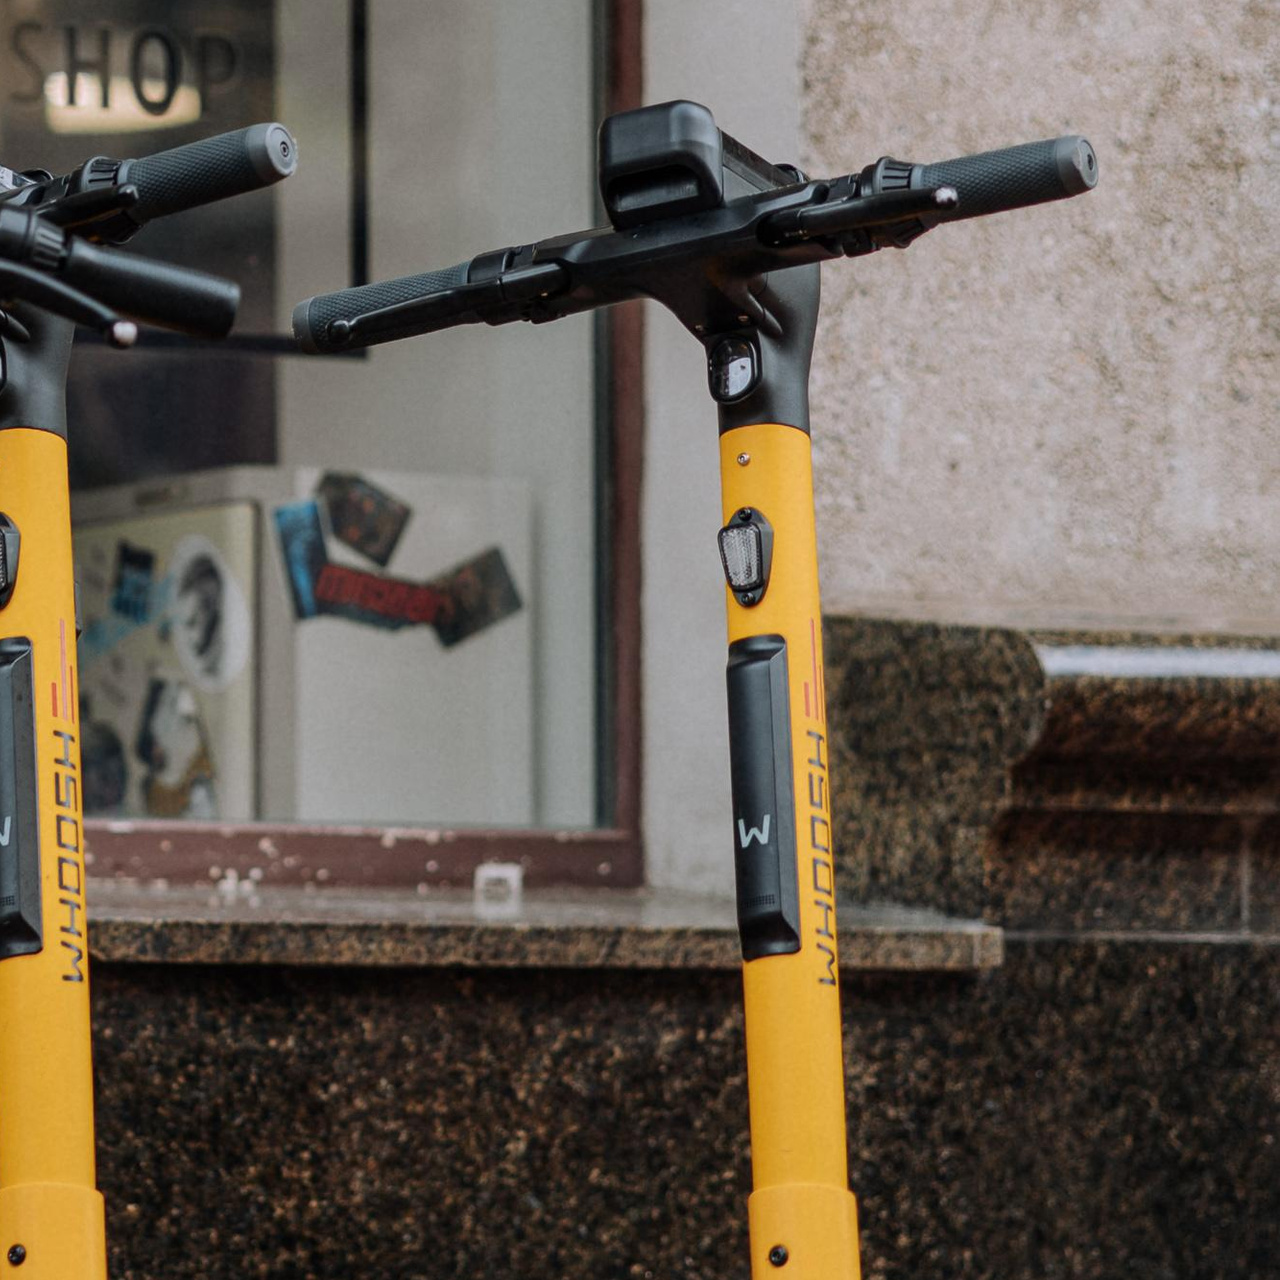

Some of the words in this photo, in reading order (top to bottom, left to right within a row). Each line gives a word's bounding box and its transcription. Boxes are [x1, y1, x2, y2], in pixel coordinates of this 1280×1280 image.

[53, 730, 84, 982] WHOOSH
[738, 814, 770, 848] W
[808, 731, 836, 986] WHOOSH
